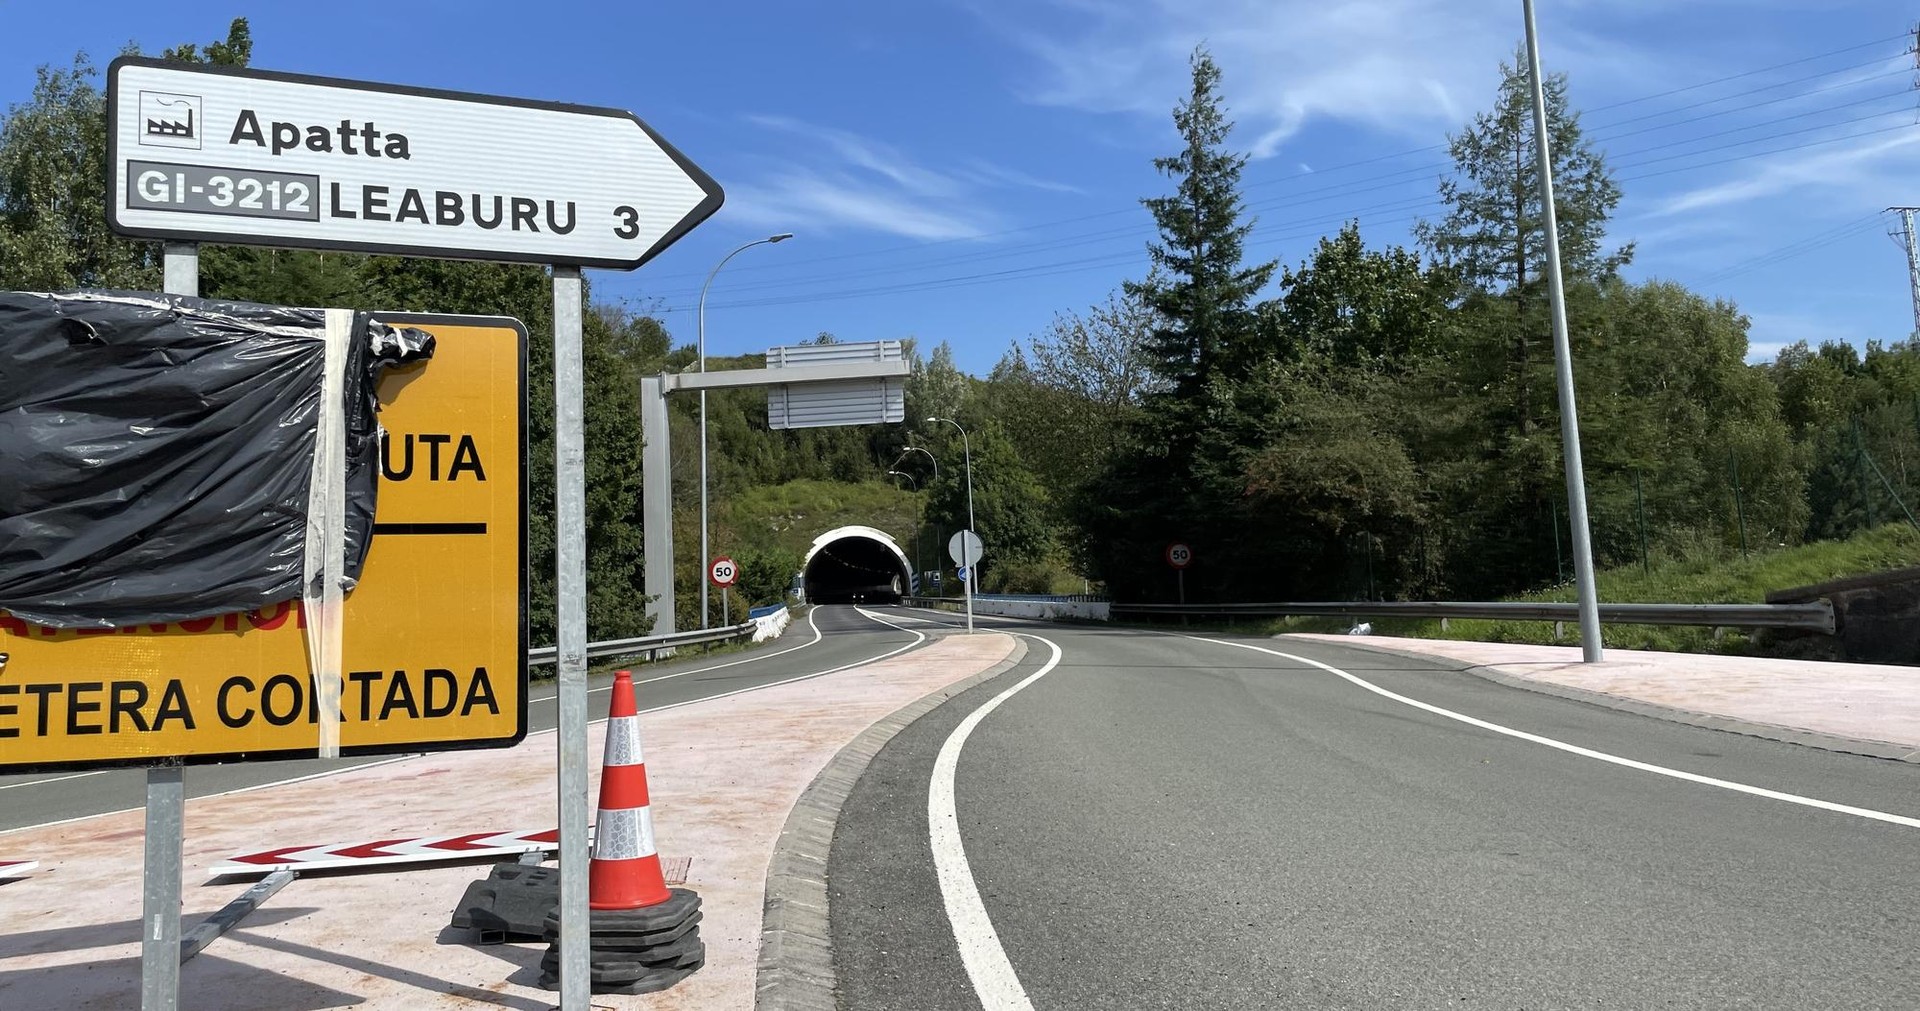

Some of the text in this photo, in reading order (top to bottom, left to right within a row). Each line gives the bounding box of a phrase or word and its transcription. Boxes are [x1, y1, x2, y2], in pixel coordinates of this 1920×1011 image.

[230, 109, 411, 160] Apatta
[138, 170, 640, 240] GI-3212 LEABURU 3
[1172, 549, 1188, 560] 50
[715, 566, 732, 577] 50
